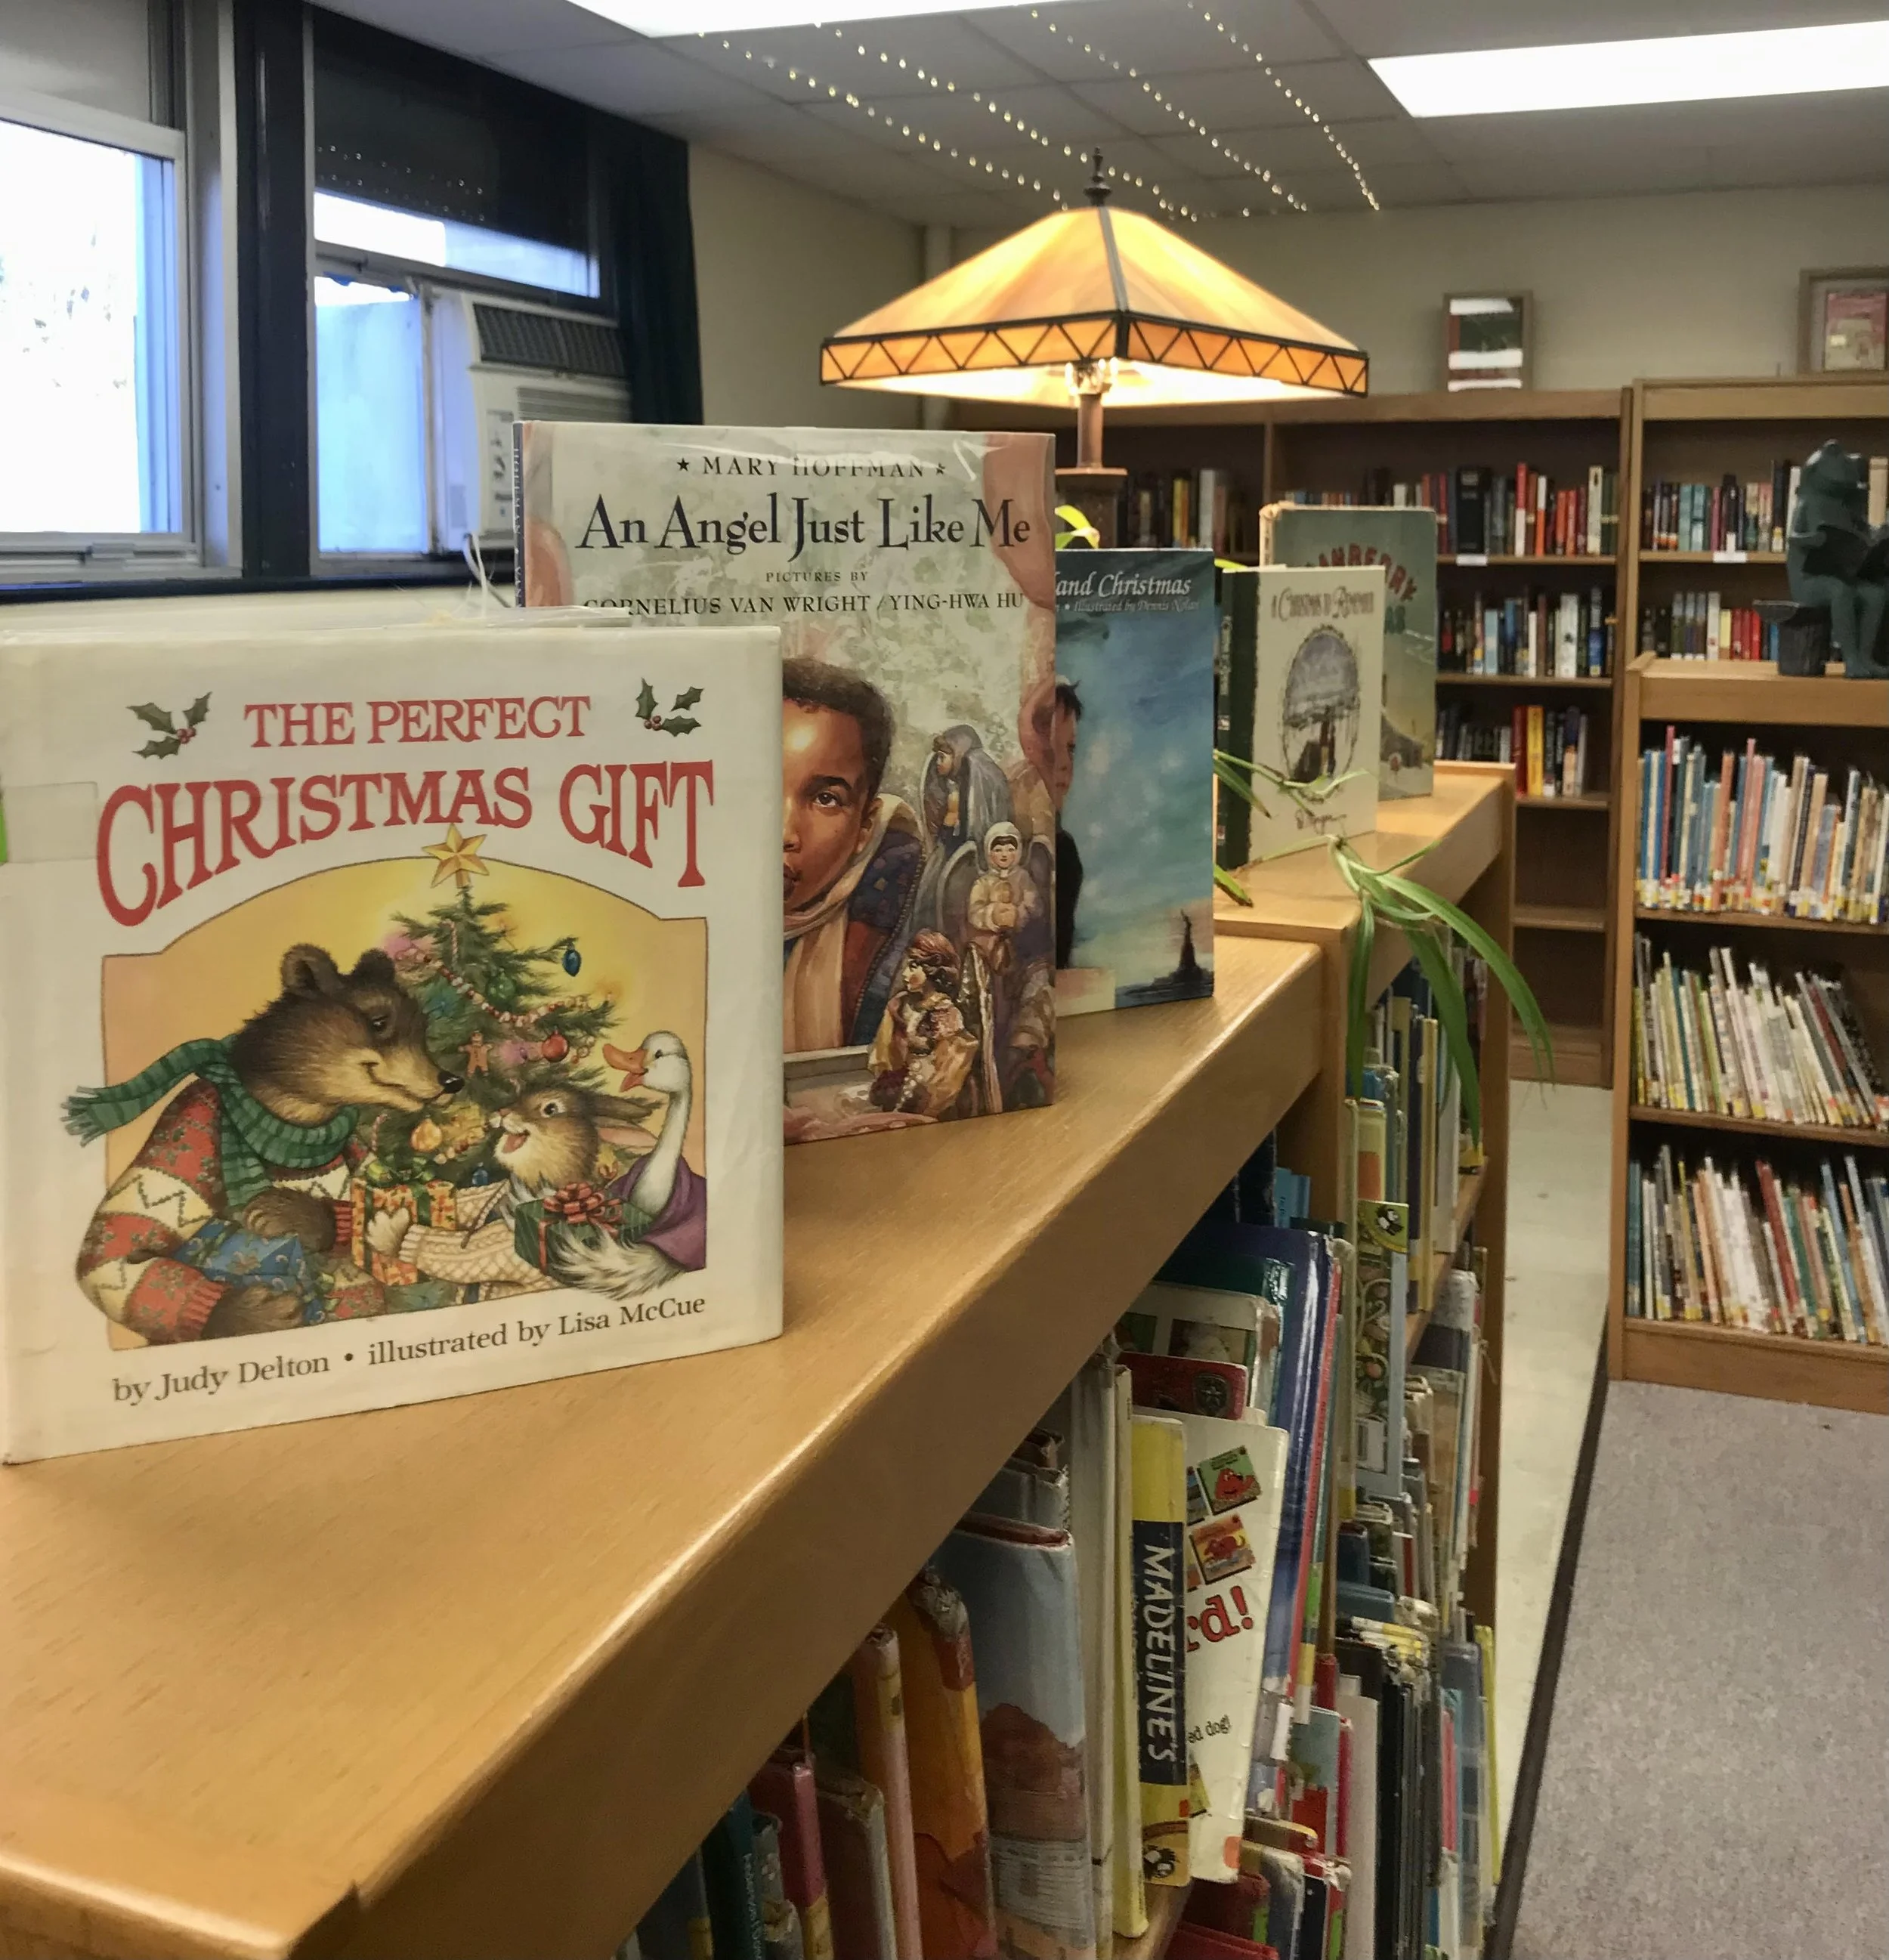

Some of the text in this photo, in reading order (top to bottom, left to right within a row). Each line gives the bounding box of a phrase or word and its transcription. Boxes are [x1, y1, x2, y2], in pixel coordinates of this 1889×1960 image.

[703, 456, 924, 478] MARY HOFFMAN
[574, 492, 1031, 562] An Angel Just Like Me
[730, 596, 774, 614] VAN
[783, 595, 870, 613] WRIGHT
[889, 593, 990, 610] YING-HWA
[997, 592, 1023, 608] HU
[765, 570, 867, 583] PICTURES BY
[1099, 570, 1192, 597] Christmas
[243, 695, 590, 749] THE PERFECT
[95, 759, 714, 926] CHRISTMAS GIFT
[112, 1297, 706, 1405] by Judy Delton illustrated by Lisa McCue
[1141, 1544, 1176, 1764] MADELINE'S
